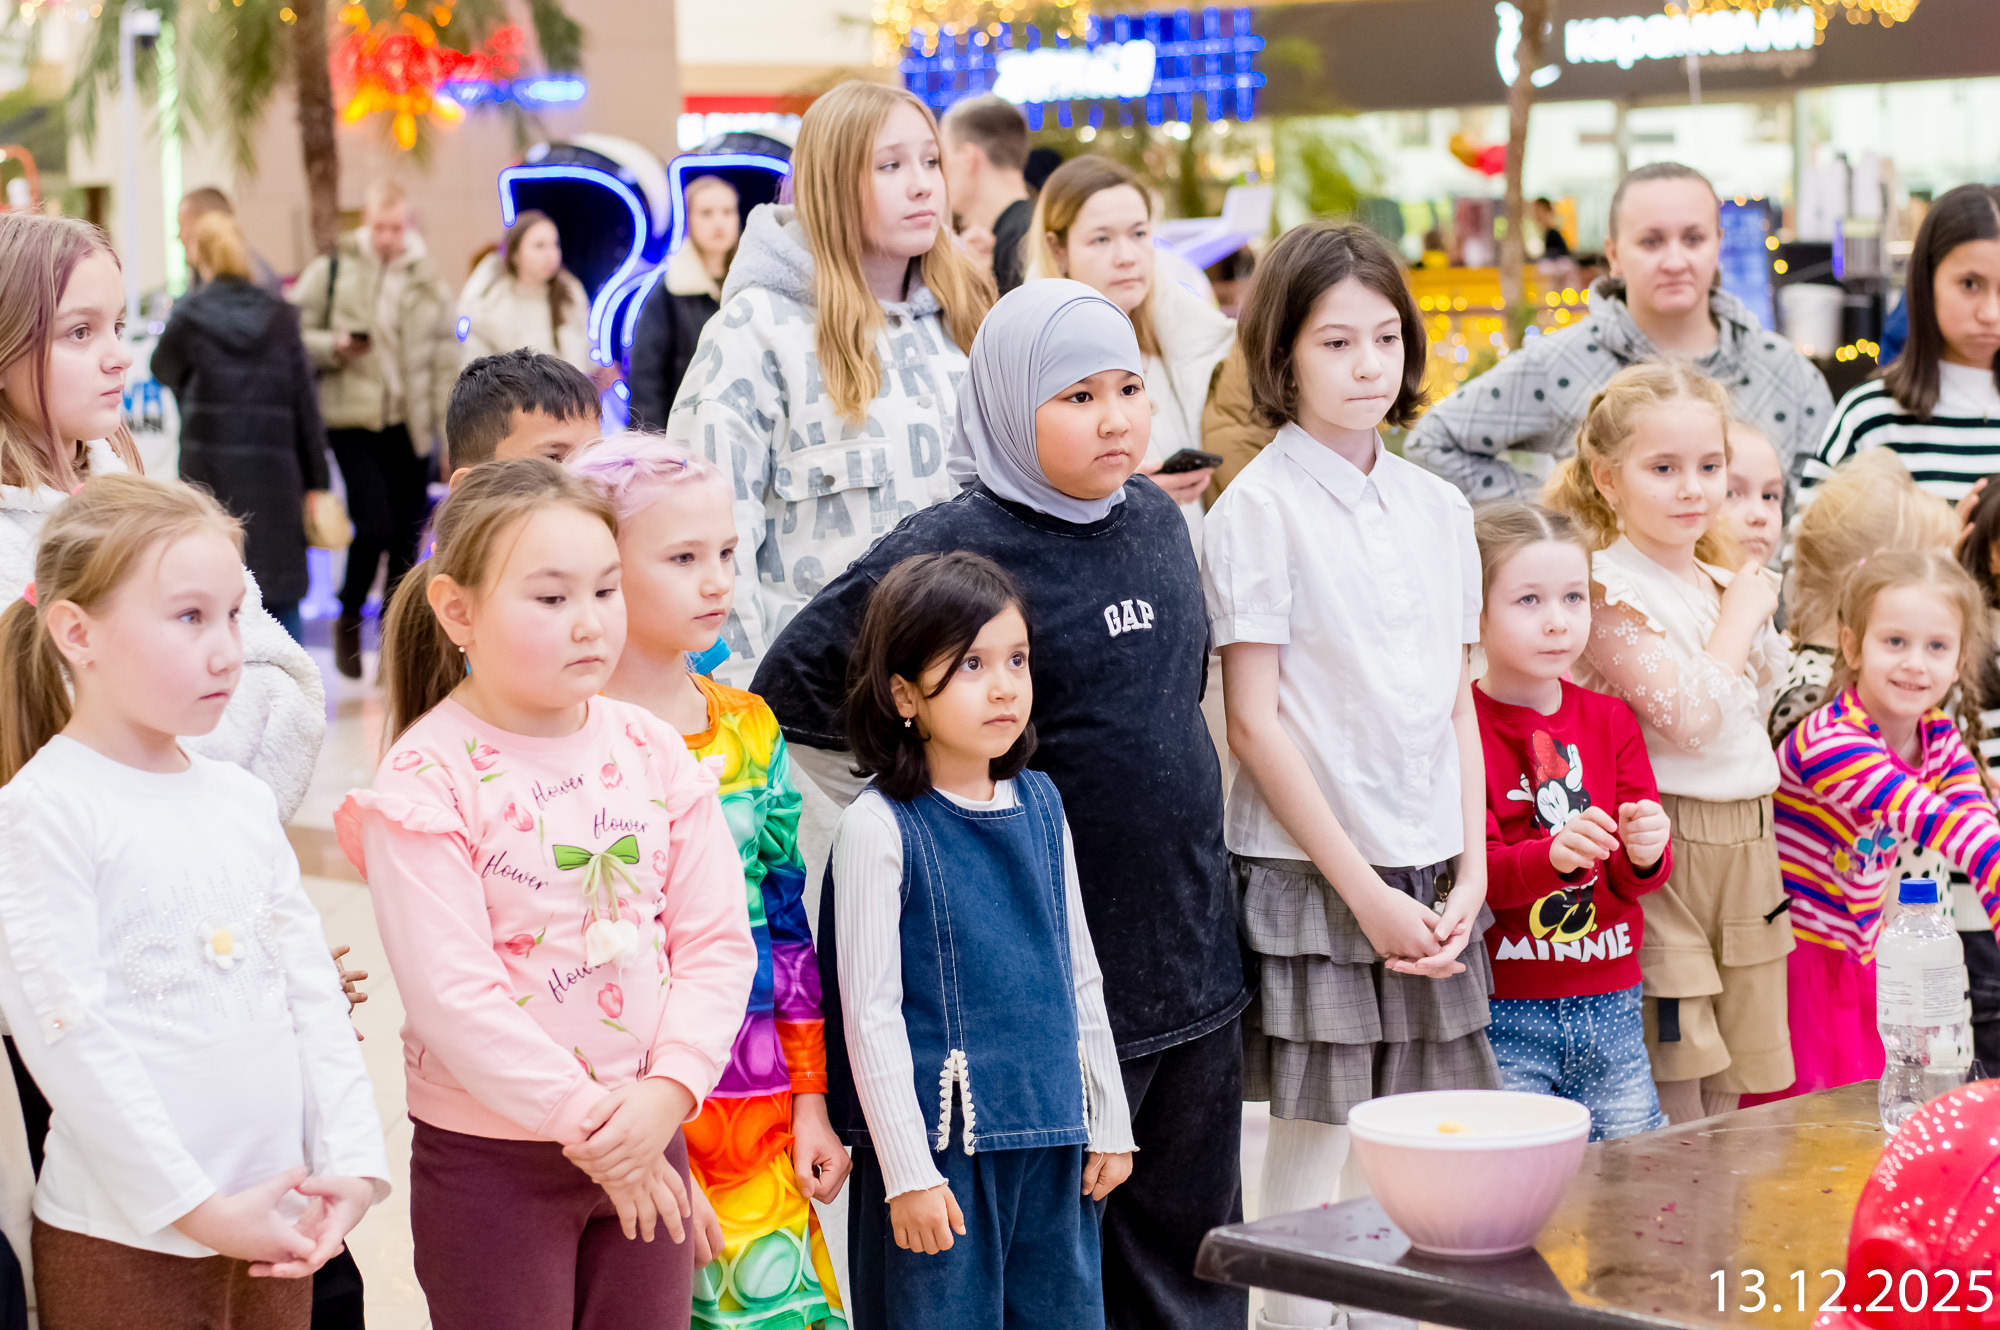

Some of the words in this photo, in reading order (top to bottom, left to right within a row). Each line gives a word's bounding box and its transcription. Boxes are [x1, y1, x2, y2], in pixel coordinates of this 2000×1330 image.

[1103, 599, 1155, 637] GAP
[1495, 922, 1634, 962] MINNIE
[548, 961, 611, 1004] flow
